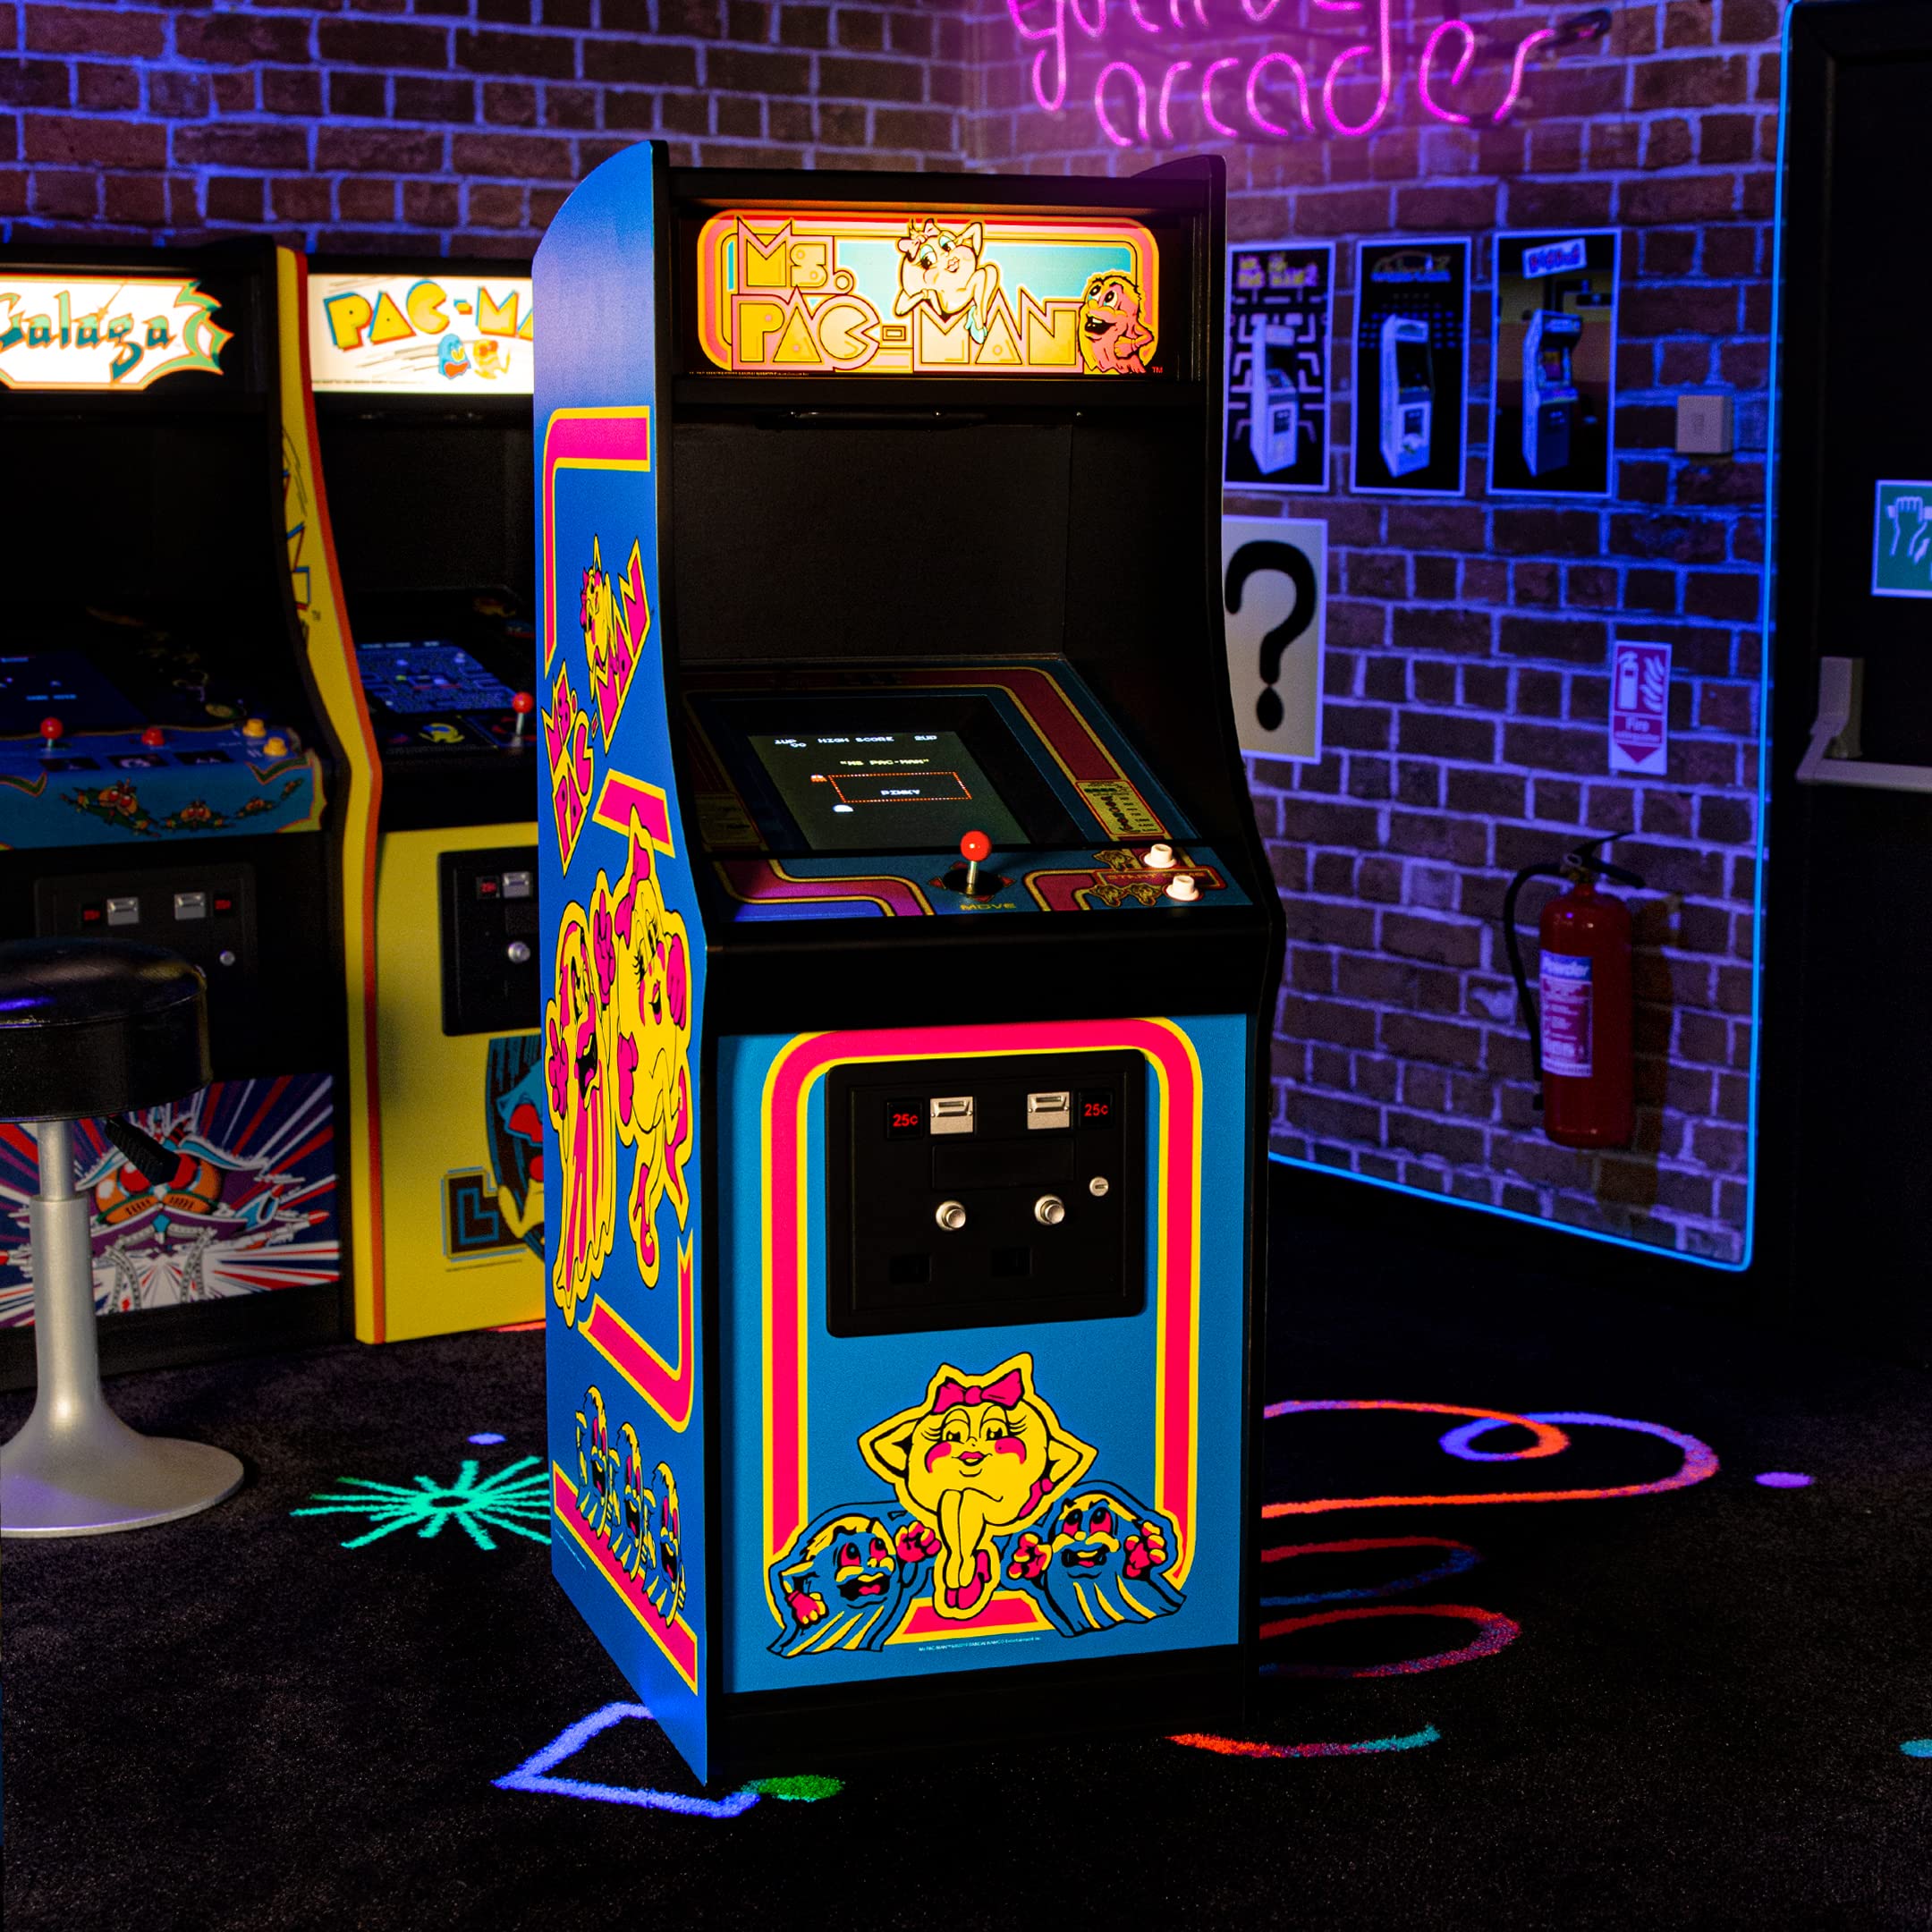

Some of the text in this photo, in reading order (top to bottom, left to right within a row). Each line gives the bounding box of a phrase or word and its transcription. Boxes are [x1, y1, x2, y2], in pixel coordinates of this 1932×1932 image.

[739, 220, 856, 293] Ms.
[733, 288, 1085, 369] PAC-MAN
[960, 902, 1016, 911] MOVE
[1084, 1103, 1108, 1116] 25¢
[893, 1114, 919, 1127] 25¢
